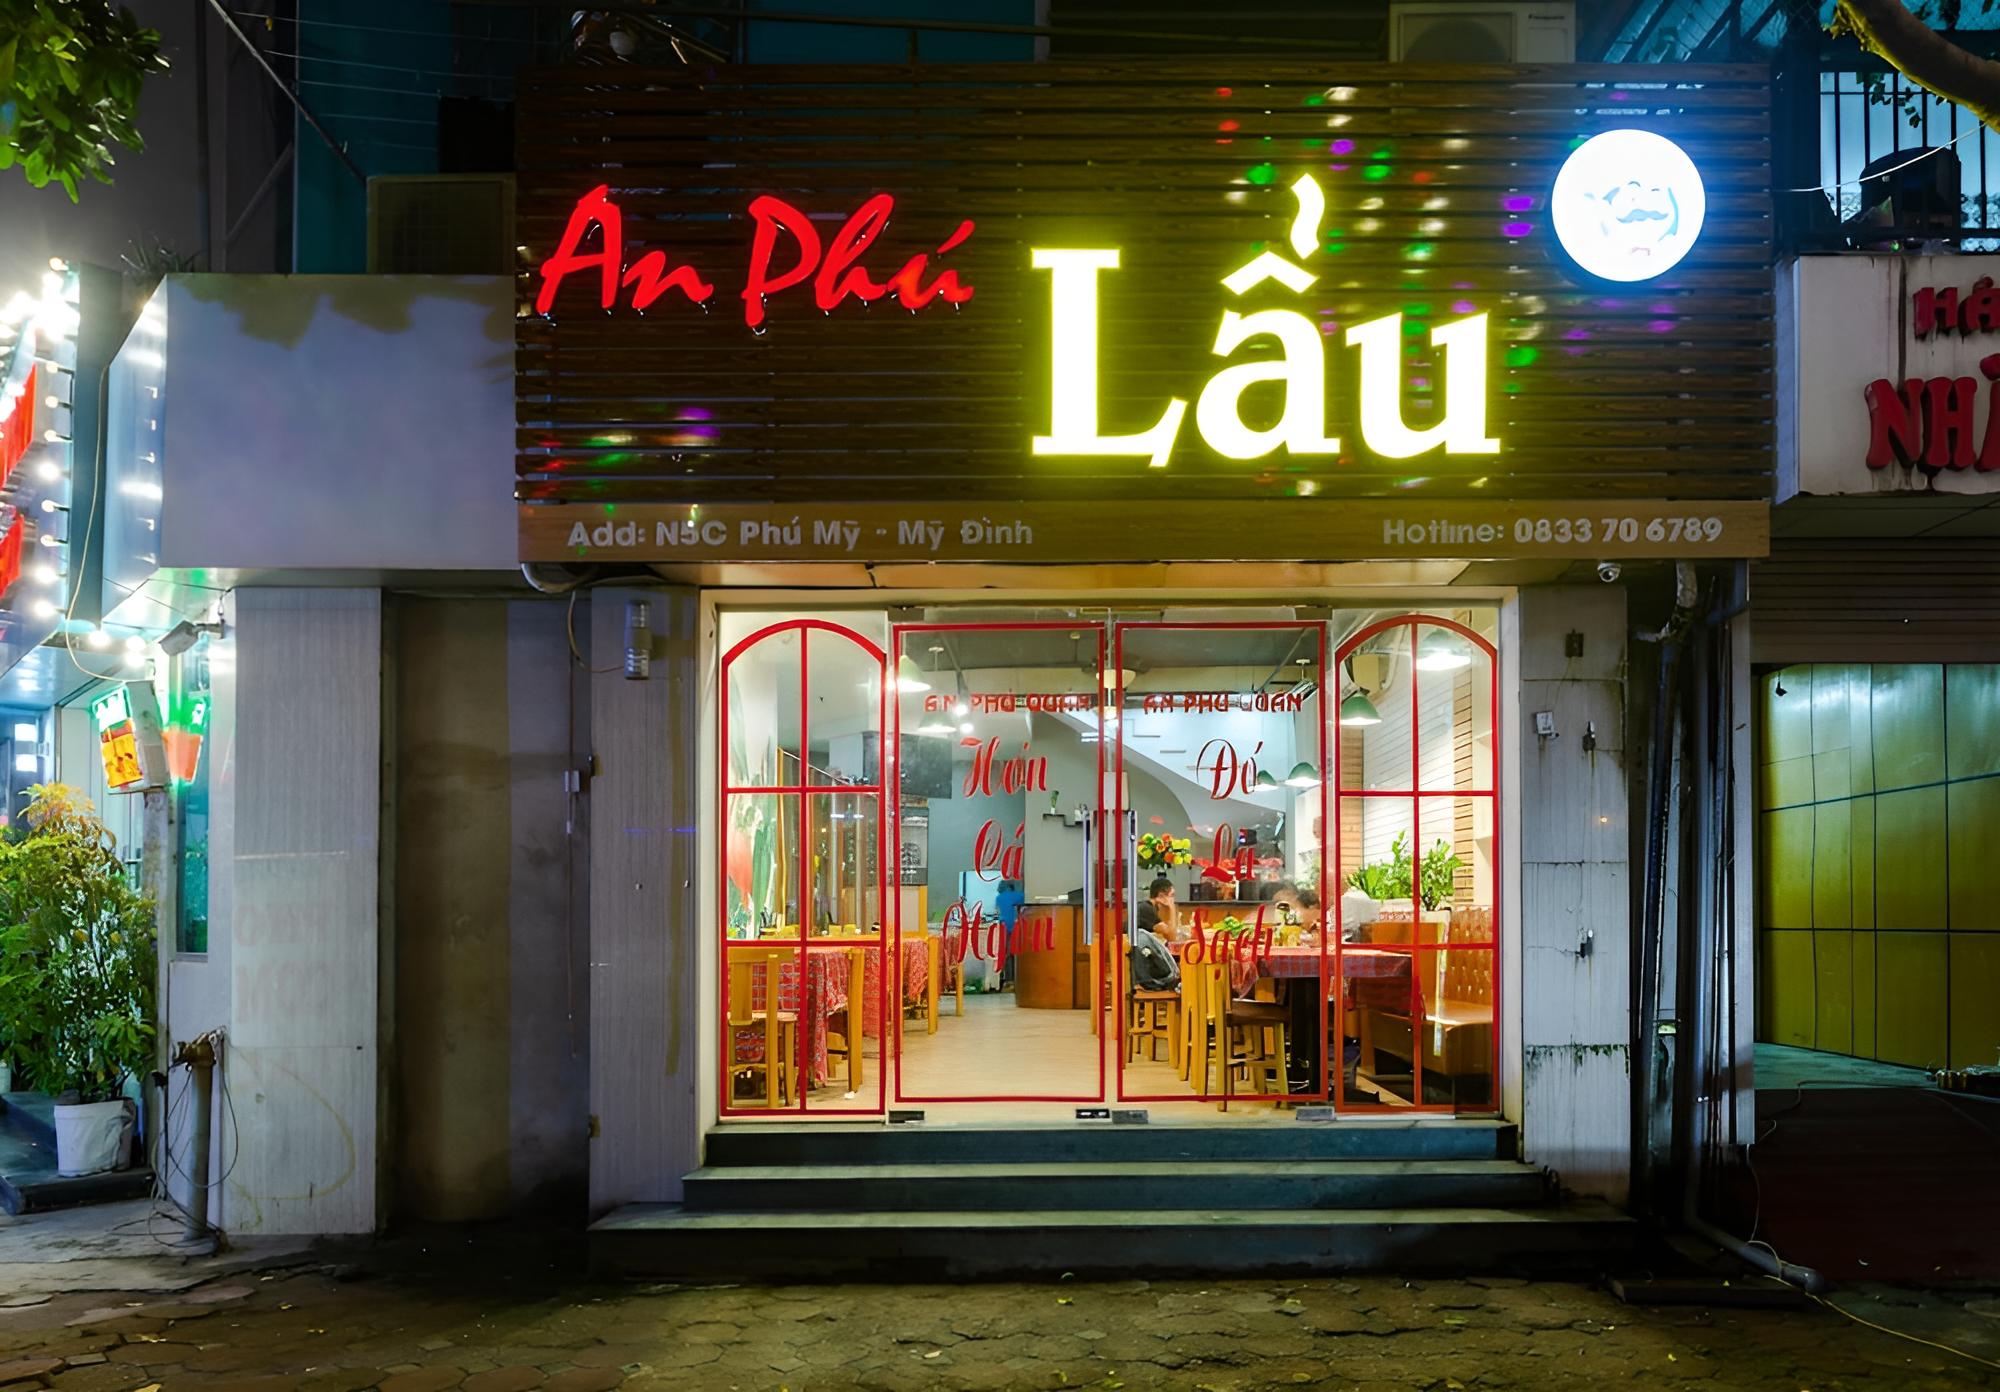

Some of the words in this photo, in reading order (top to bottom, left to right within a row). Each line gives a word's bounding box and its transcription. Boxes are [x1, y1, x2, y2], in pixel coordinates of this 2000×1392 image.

[536, 184, 714, 314] An
[741, 193, 975, 327] Phú
[568, 520, 646, 547] Add:
[740, 515, 801, 546] Phú
[813, 520, 861, 552] Mỹ
[898, 520, 945, 551] Mỹ
[960, 515, 1034, 545] Đình
[1383, 518, 1505, 545] Hotline:
[1514, 517, 1593, 544] 0833
[1601, 517, 1640, 543] 70
[1645, 516, 1723, 544] 6789
